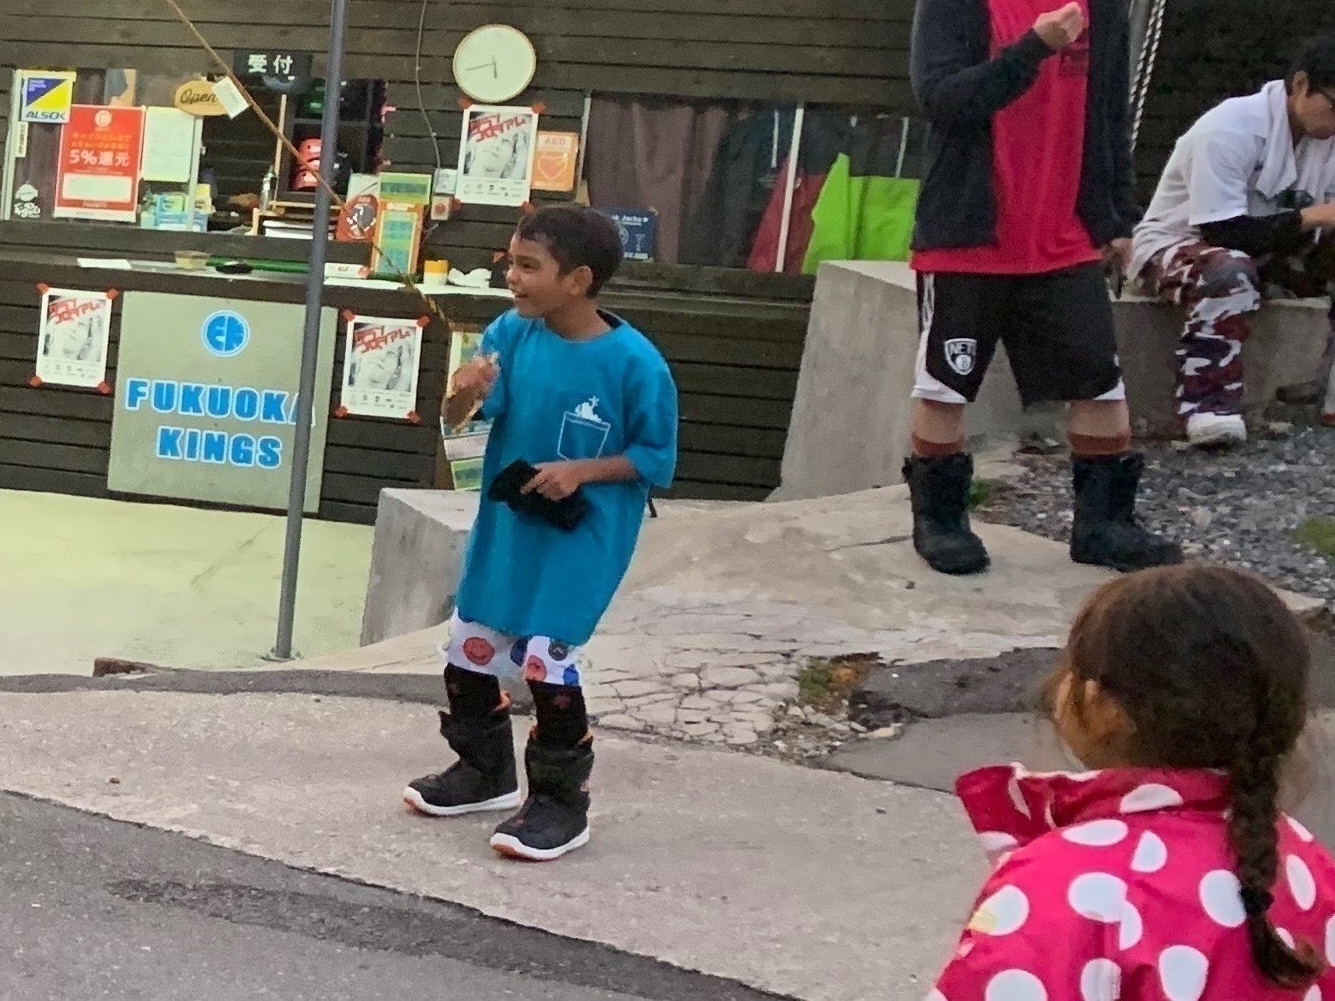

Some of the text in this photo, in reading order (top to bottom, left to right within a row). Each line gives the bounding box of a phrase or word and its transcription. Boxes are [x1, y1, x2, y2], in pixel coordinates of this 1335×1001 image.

[248, 54, 293, 75] 受付
[180, 88, 217, 104] Open
[26, 110, 66, 121] ALSOK
[69, 149, 130, 167] 5%還元
[156, 425, 283, 470] KINGS
